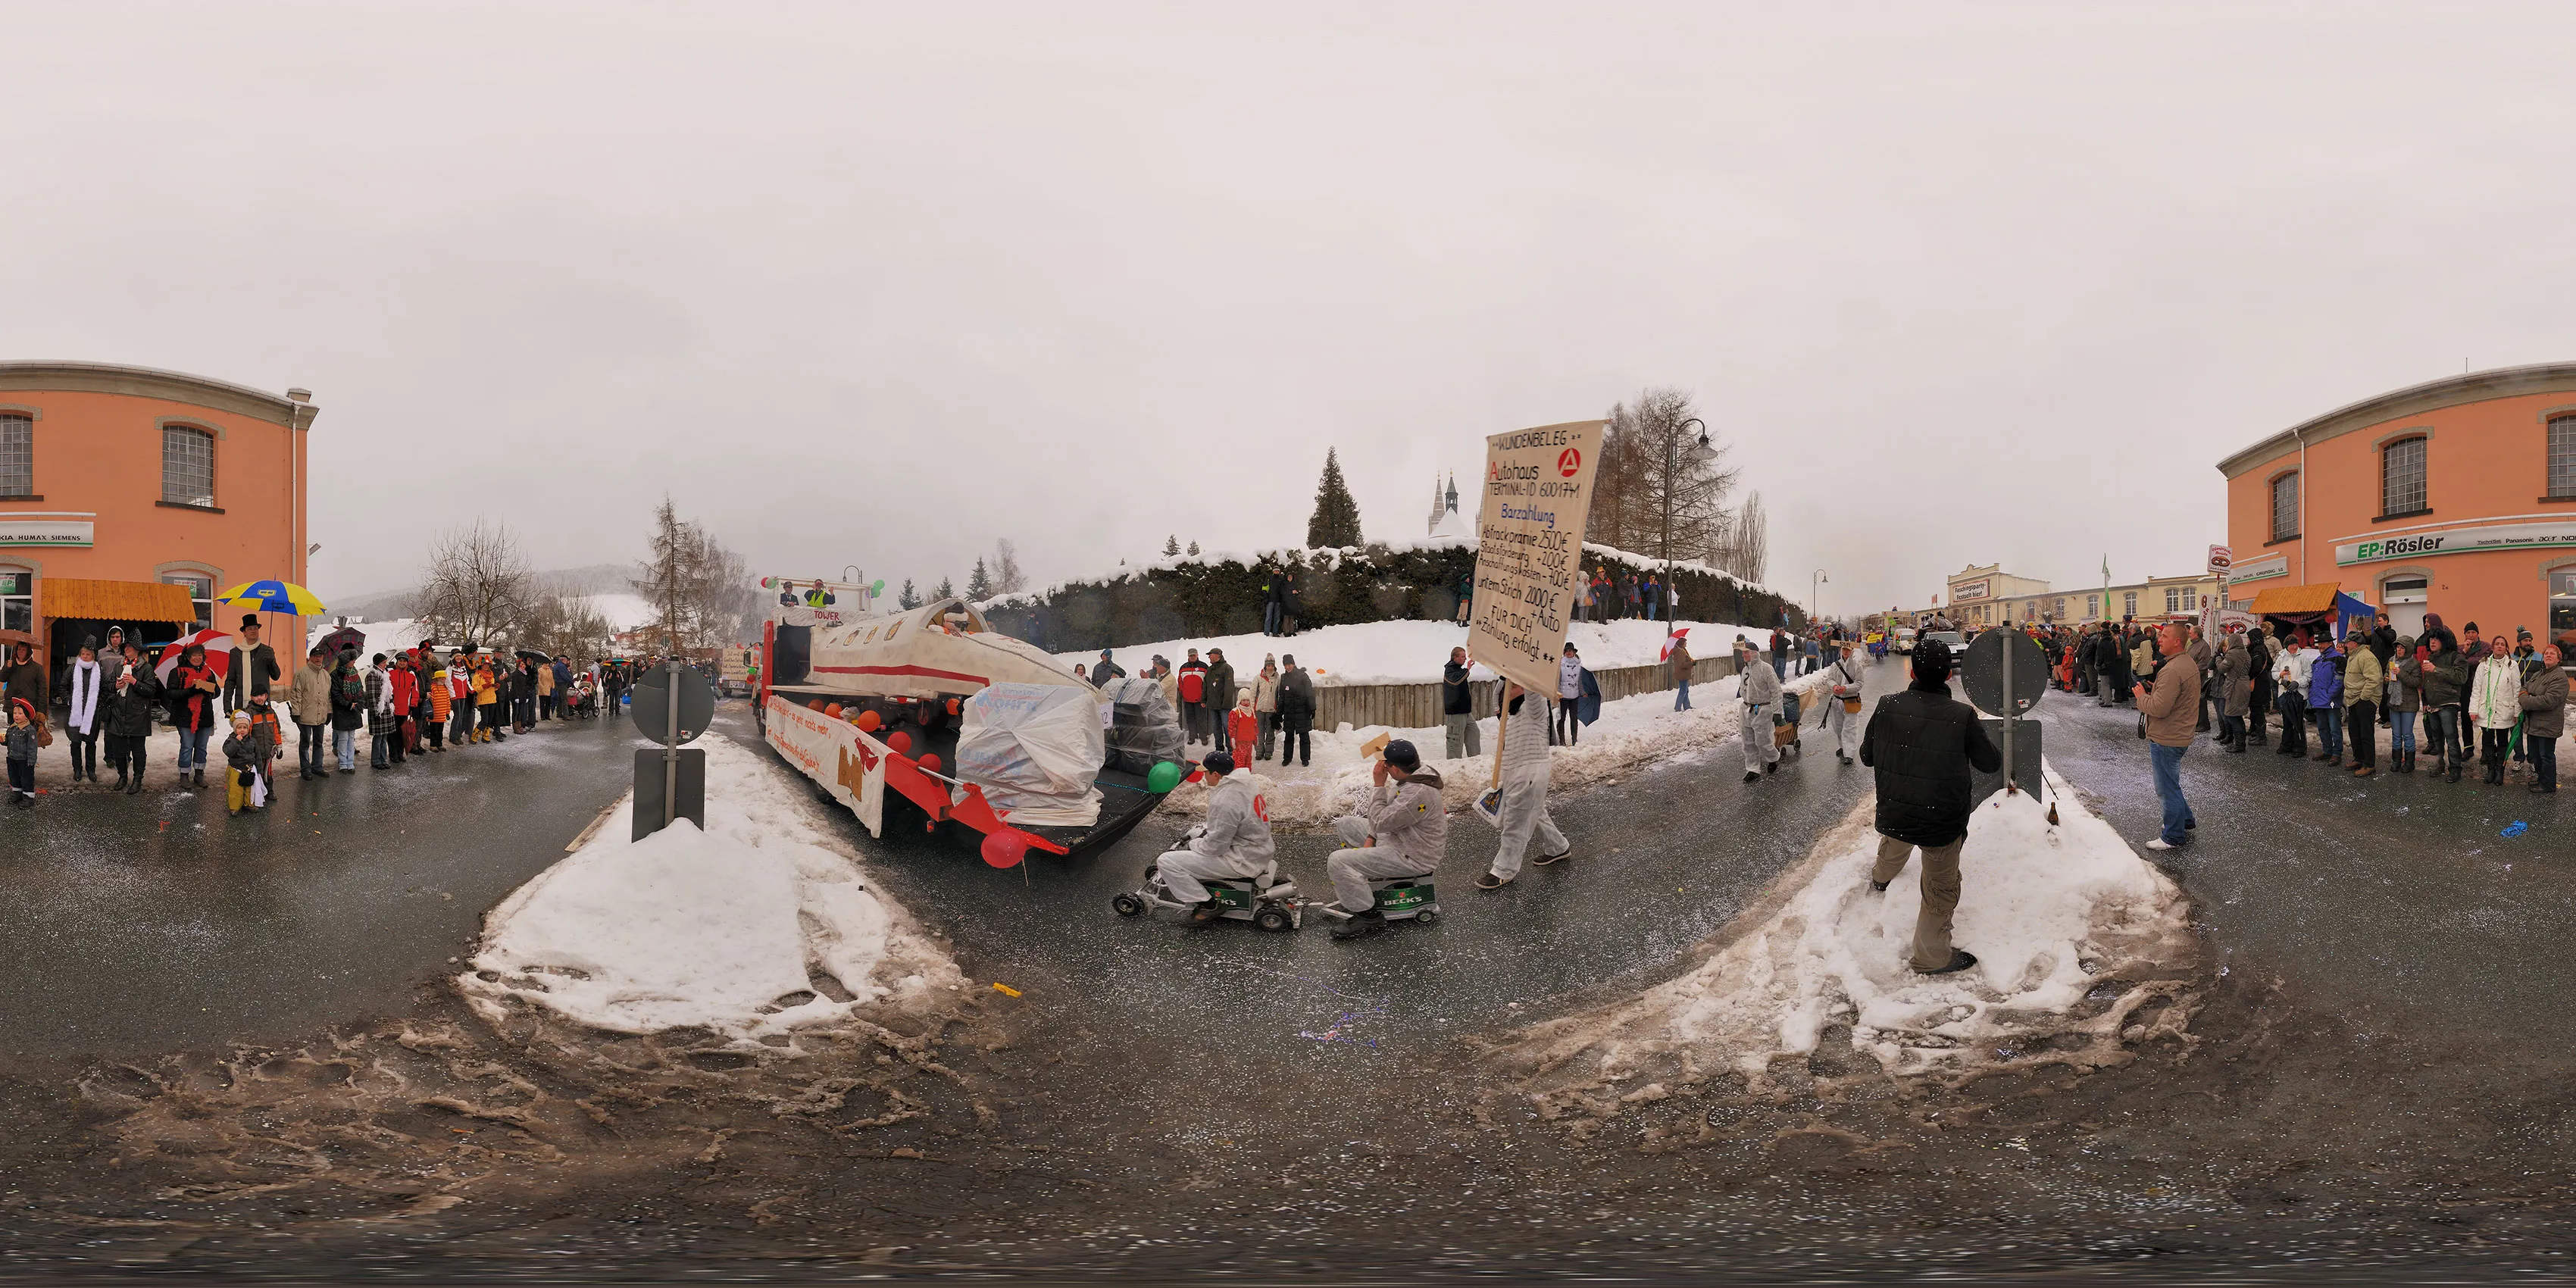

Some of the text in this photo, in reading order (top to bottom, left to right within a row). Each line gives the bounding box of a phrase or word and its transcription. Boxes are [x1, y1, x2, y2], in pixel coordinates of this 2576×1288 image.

[1489, 459, 1539, 481] Autohaus
[1489, 482, 1537, 496] TERMINAL-ID
[1501, 503, 1555, 529] Barzahlung
[814, 610, 839, 621] TOWER
[1510, 613, 1533, 634] DICH
[1512, 634, 1540, 662] erfolgt
[1383, 896, 1423, 906] BECK'S
